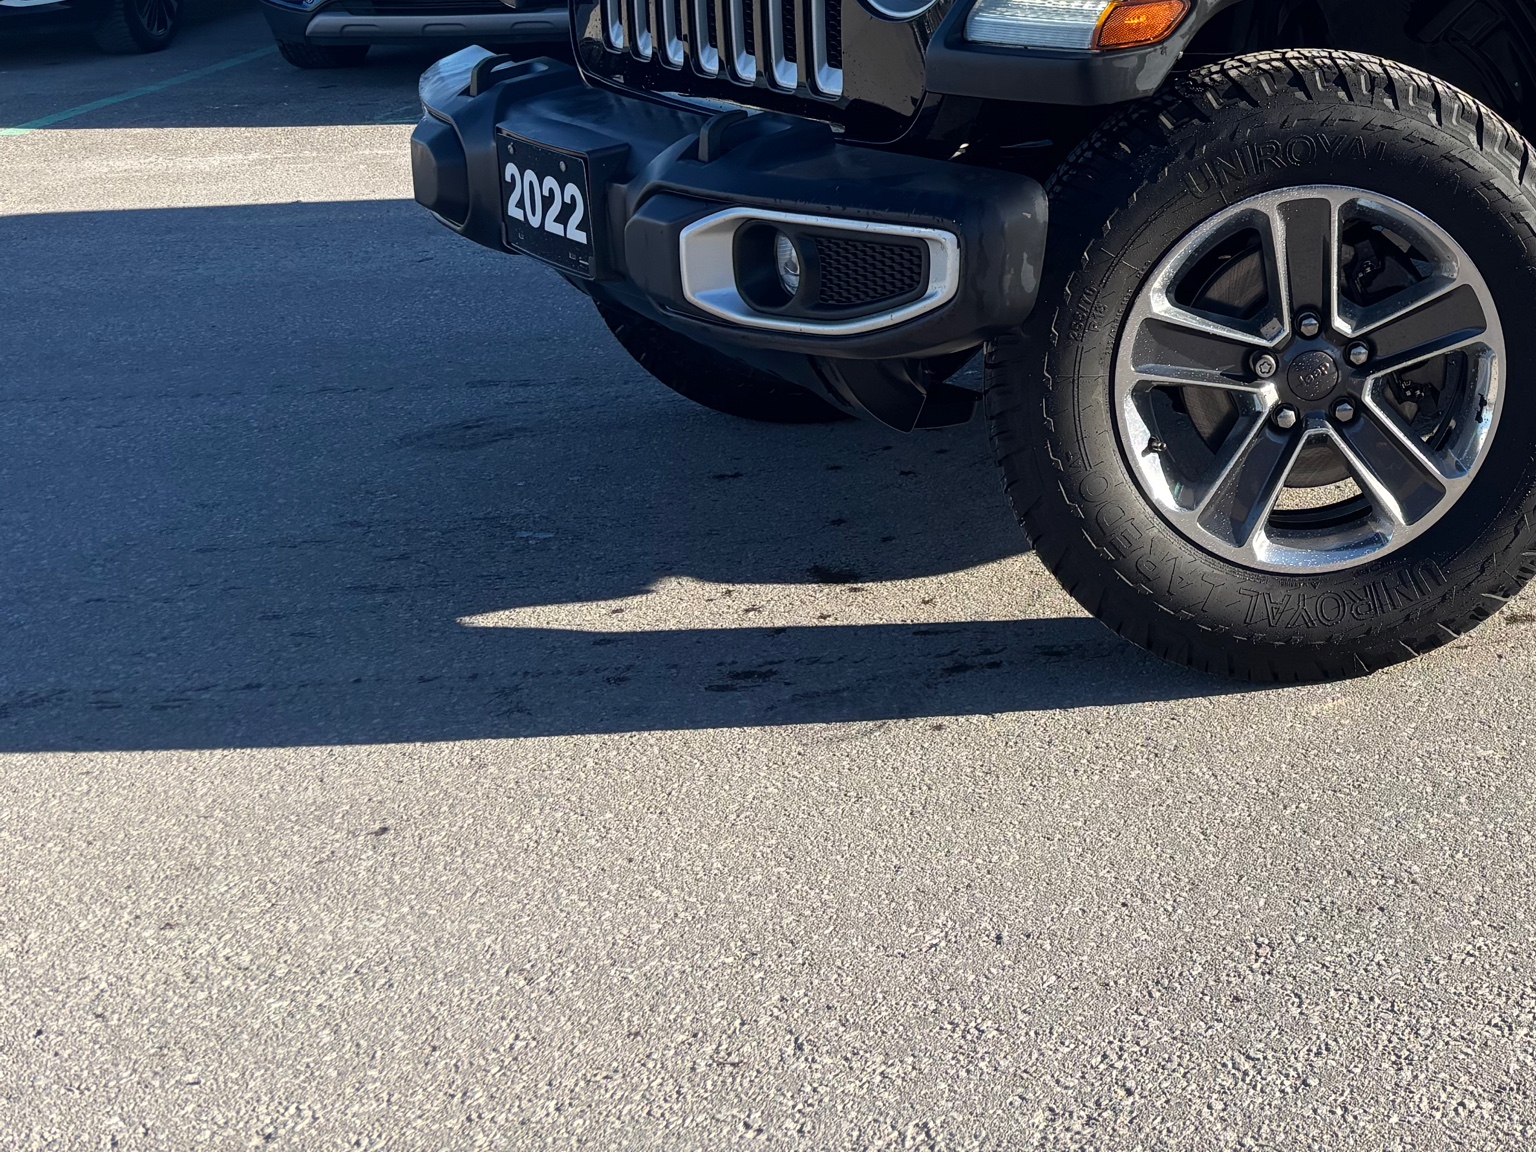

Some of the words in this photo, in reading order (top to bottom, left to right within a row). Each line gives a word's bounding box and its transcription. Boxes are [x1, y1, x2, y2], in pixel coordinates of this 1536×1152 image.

[1181, 132, 1388, 198] UNIROYAL
[504, 161, 588, 245] 2022
[1239, 557, 1448, 629] UNIROYAL
